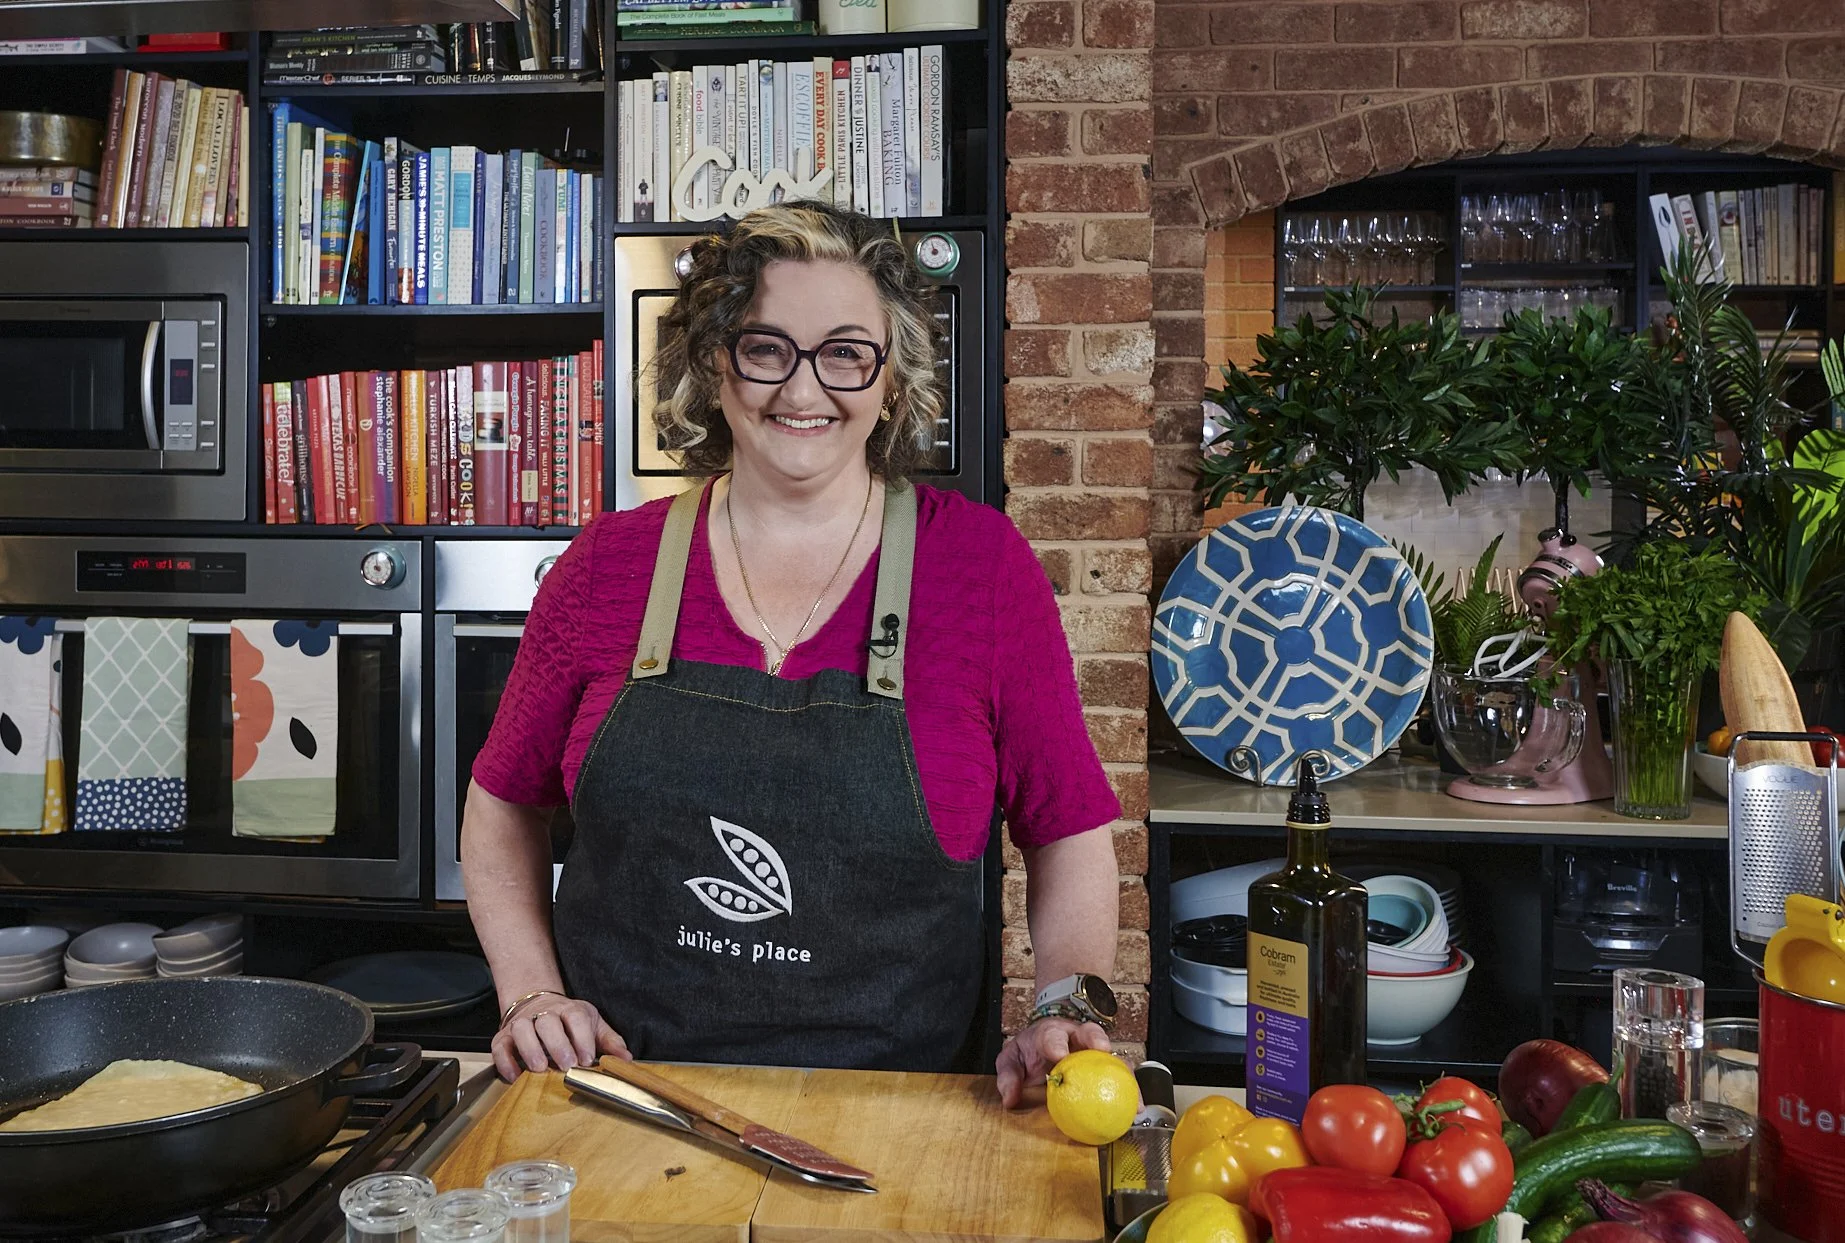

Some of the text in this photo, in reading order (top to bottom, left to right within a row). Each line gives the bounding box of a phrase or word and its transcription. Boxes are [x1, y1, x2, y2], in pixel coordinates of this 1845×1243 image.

[425, 73, 495, 85] CUISINE TEMPS
[738, 75, 746, 100] TART
[870, 75, 878, 102] relaxed
[110, 96, 121, 151] The Food Clock
[167, 89, 184, 161] THE 20/20 DIET COOKBOOK
[212, 101, 225, 138] LOCAL
[696, 90, 704, 135] food bible
[711, 98, 721, 147] the VINTAGE
[738, 112, 747, 129] UP!
[739, 101, 746, 110] IT
[795, 73, 811, 147] ESCOFFIE
[816, 71, 825, 161] EVERY DAY COOK
[853, 67, 864, 154] DINNER JUSTINE
[869, 104, 879, 135] cooking
[930, 55, 940, 161] GORDON RAMSAY'S
[837, 90, 846, 183] LITTLE PARIS KITCHEN
[890, 99, 903, 185] Margaret Fulton
[208, 145, 220, 187] LOVELY
[331, 152, 342, 189] Complete
[418, 156, 427, 197] JAMIE'S
[883, 130, 893, 186] BAKING
[387, 168, 397, 231] GARY MEHIGAN
[401, 160, 410, 200] GORDON
[331, 190, 340, 216] Middle
[433, 171, 445, 270] MATT PRESTON
[522, 193, 531, 216] Notes
[329, 218, 339, 248] Eastern
[539, 220, 549, 280] COOKBOOK
[417, 253, 425, 288] MEALS
[582, 356, 591, 416] FOOD SAFARI
[375, 376, 386, 476] stephanie alexander
[383, 377, 395, 482] the cook's companion
[511, 405, 519, 432] Porgie
[524, 376, 536, 461] A homegrown table
[540, 400, 549, 436] FAKING
[594, 422, 603, 445] SPICY
[276, 405, 294, 487] celebrate!
[295, 434, 308, 484] grillhouse
[332, 421, 345, 500] TEXAS BARBECUE
[410, 419, 418, 461] KITCHEN
[556, 428, 565, 495] CHRISTMAS
[1607, 883, 1638, 892] Breville
[677, 925, 812, 964] julie's place
[1260, 946, 1296, 963] Cobram
[1268, 960, 1286, 969] Estate
